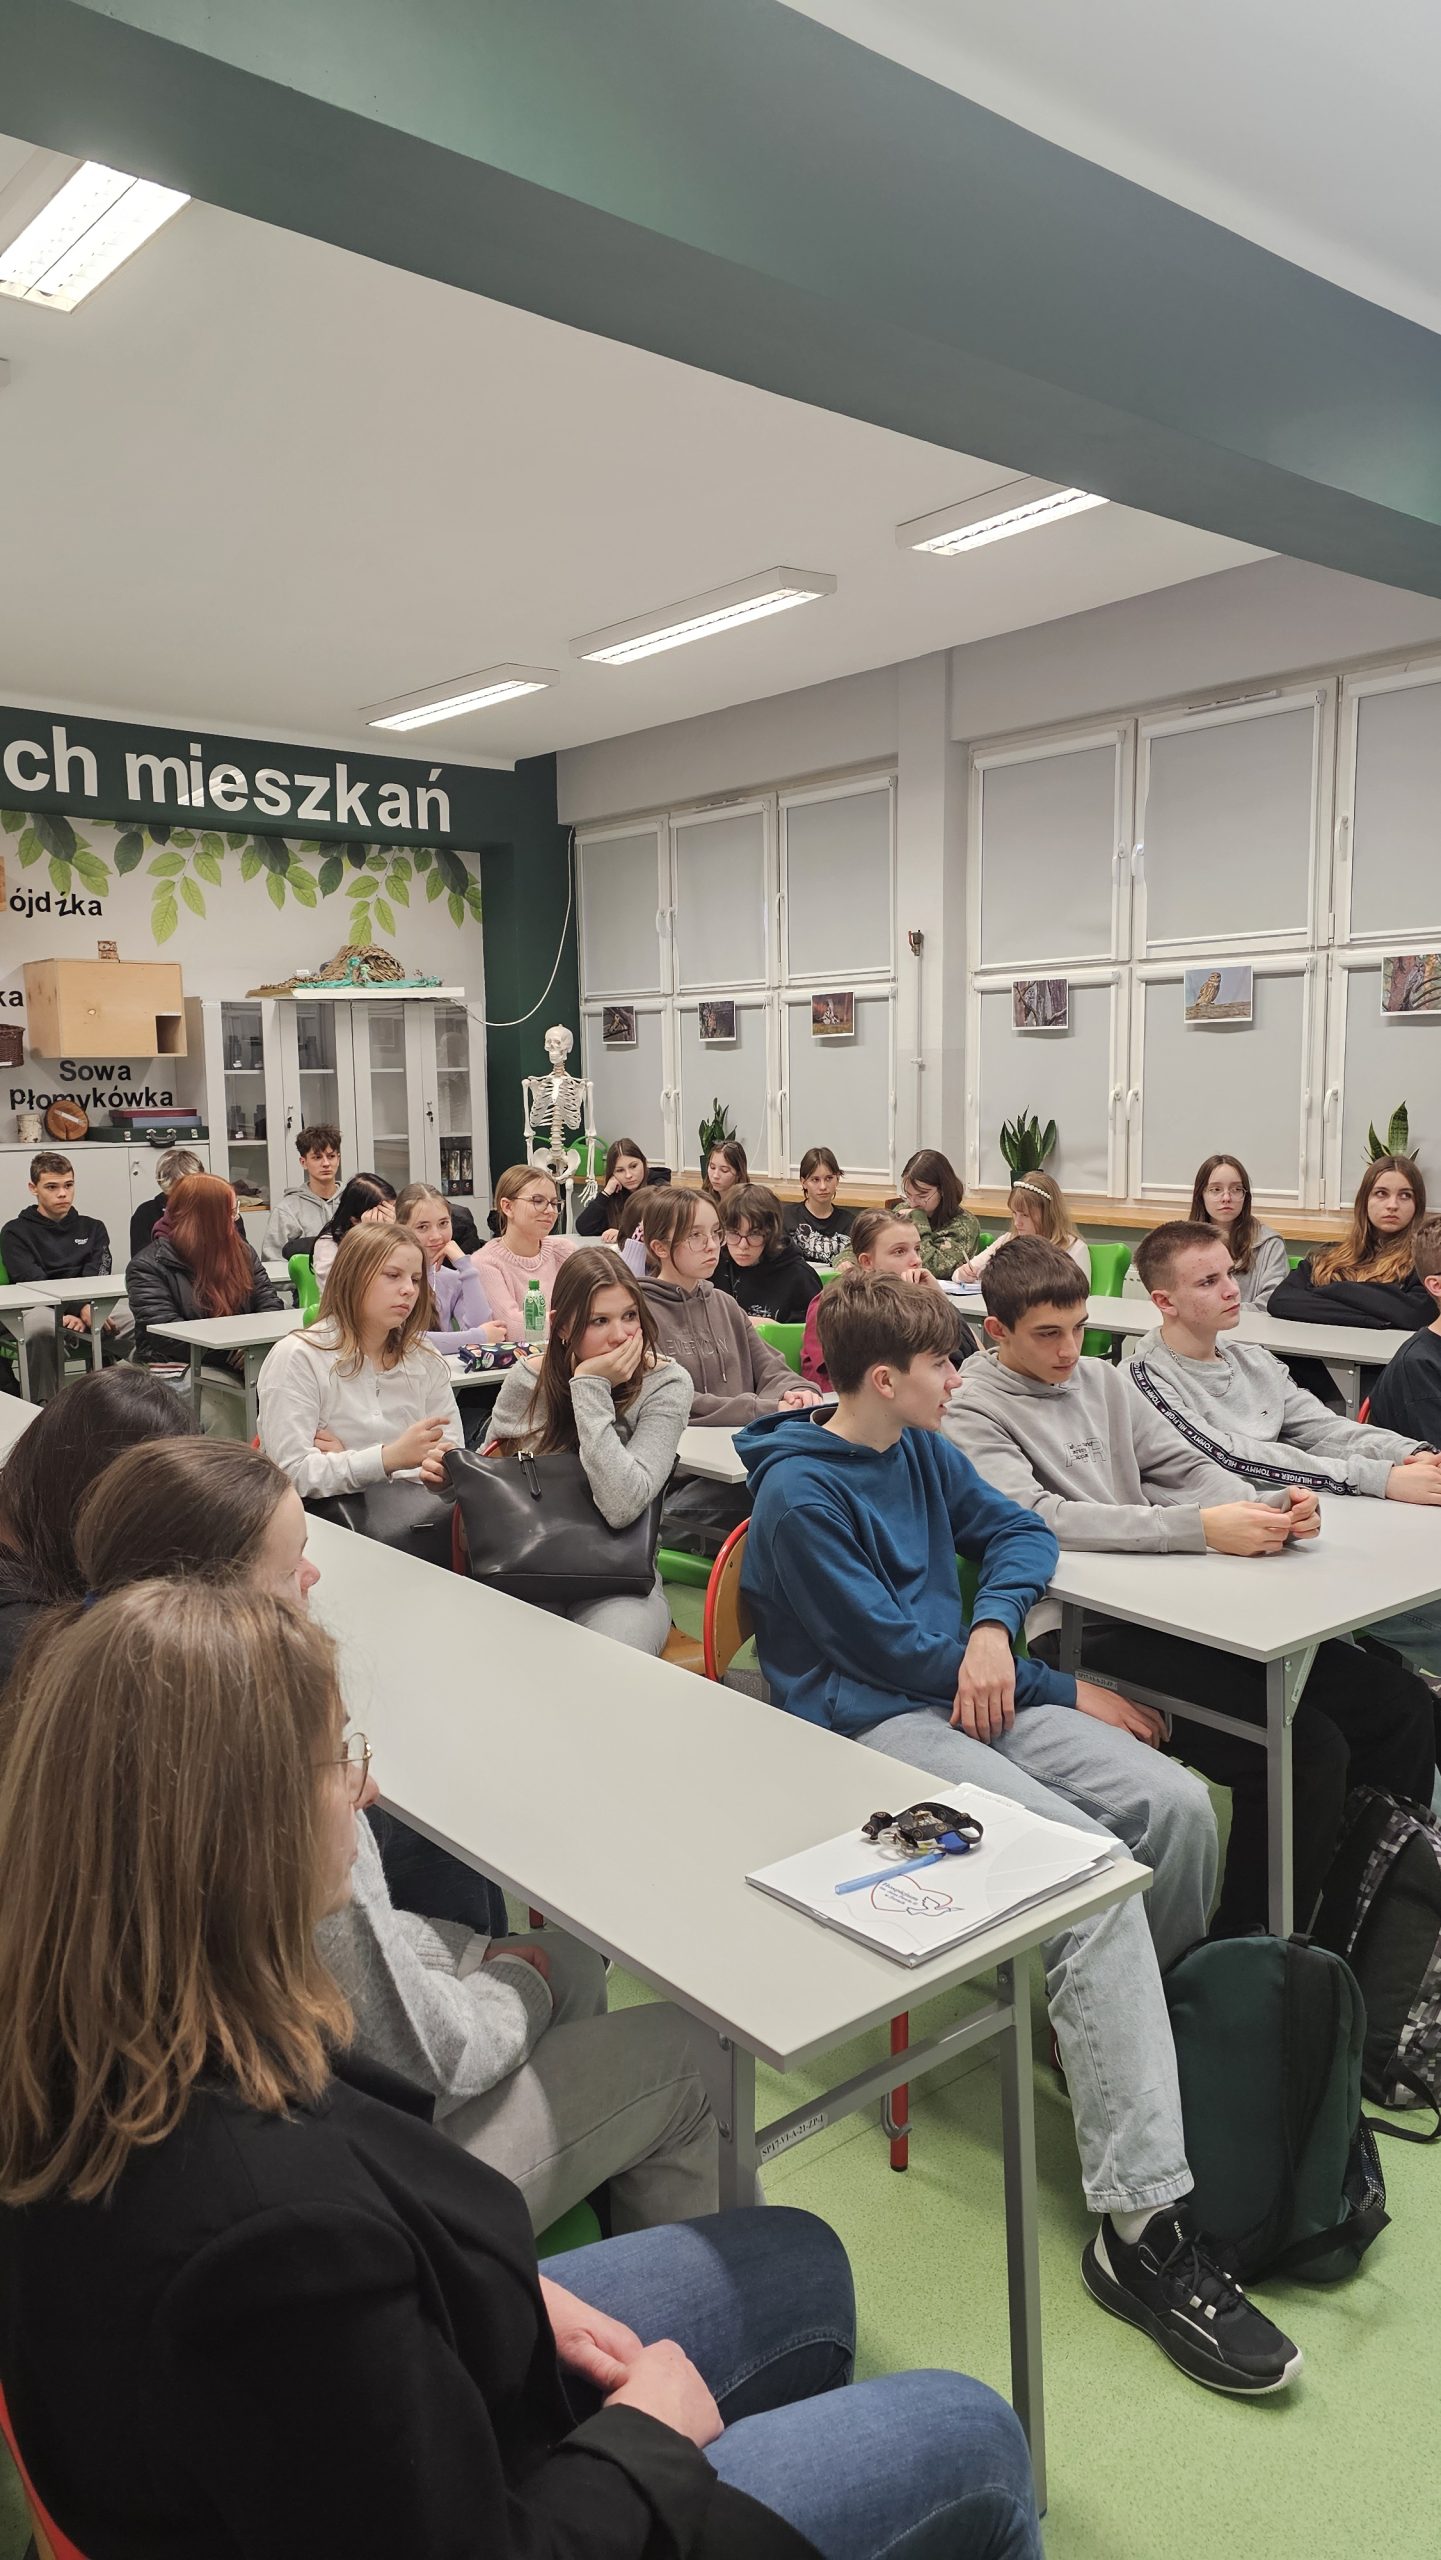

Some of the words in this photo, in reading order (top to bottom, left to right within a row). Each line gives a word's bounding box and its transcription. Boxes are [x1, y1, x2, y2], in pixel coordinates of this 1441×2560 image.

[3, 726, 98, 797] ch
[125, 742, 451, 833] mieszkań
[59, 1060, 131, 1081] Sowa
[9, 1085, 173, 1111] płomykówka
[1142, 1386, 1161, 1406] TOMMY
[1191, 1434, 1214, 1452] TOMMY
[1244, 1465, 1271, 1477] TOMMY
[1281, 1472, 1313, 1485] HILFIGER
